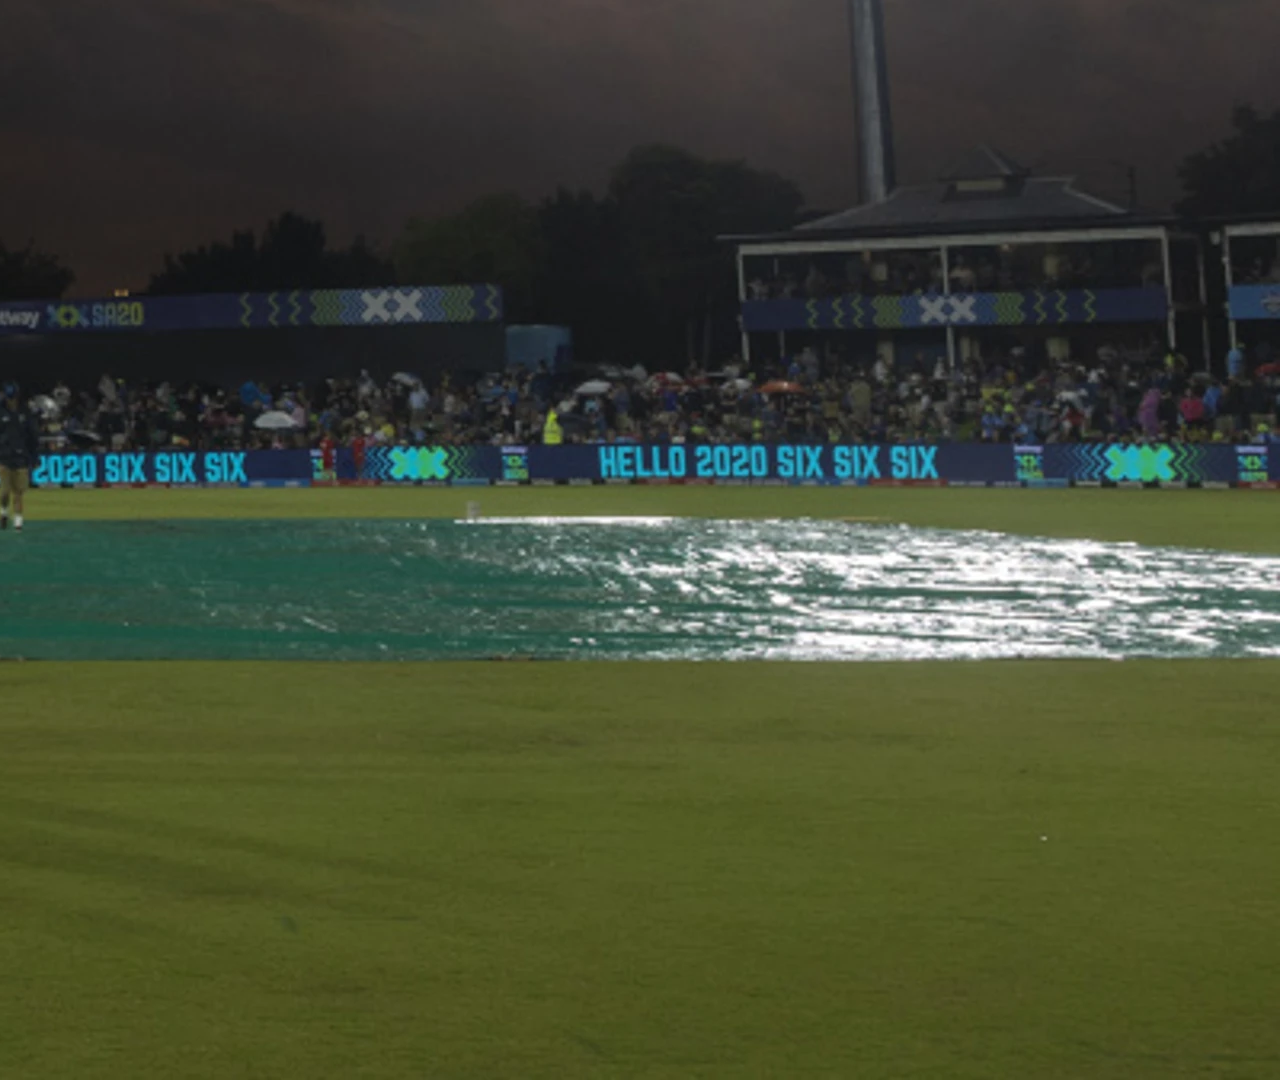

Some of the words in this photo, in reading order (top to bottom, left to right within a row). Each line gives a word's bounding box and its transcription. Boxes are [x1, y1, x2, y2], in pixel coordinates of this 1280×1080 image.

[92, 303, 144, 326] SA20
[104, 453, 147, 483] SIX
[153, 452, 197, 483] SIX
[204, 451, 248, 483] SIX
[598, 445, 687, 478] HELLO
[695, 444, 769, 478] 2020
[776, 444, 824, 478] SIX
[833, 445, 880, 479] SIX
[890, 445, 939, 479] SIX
